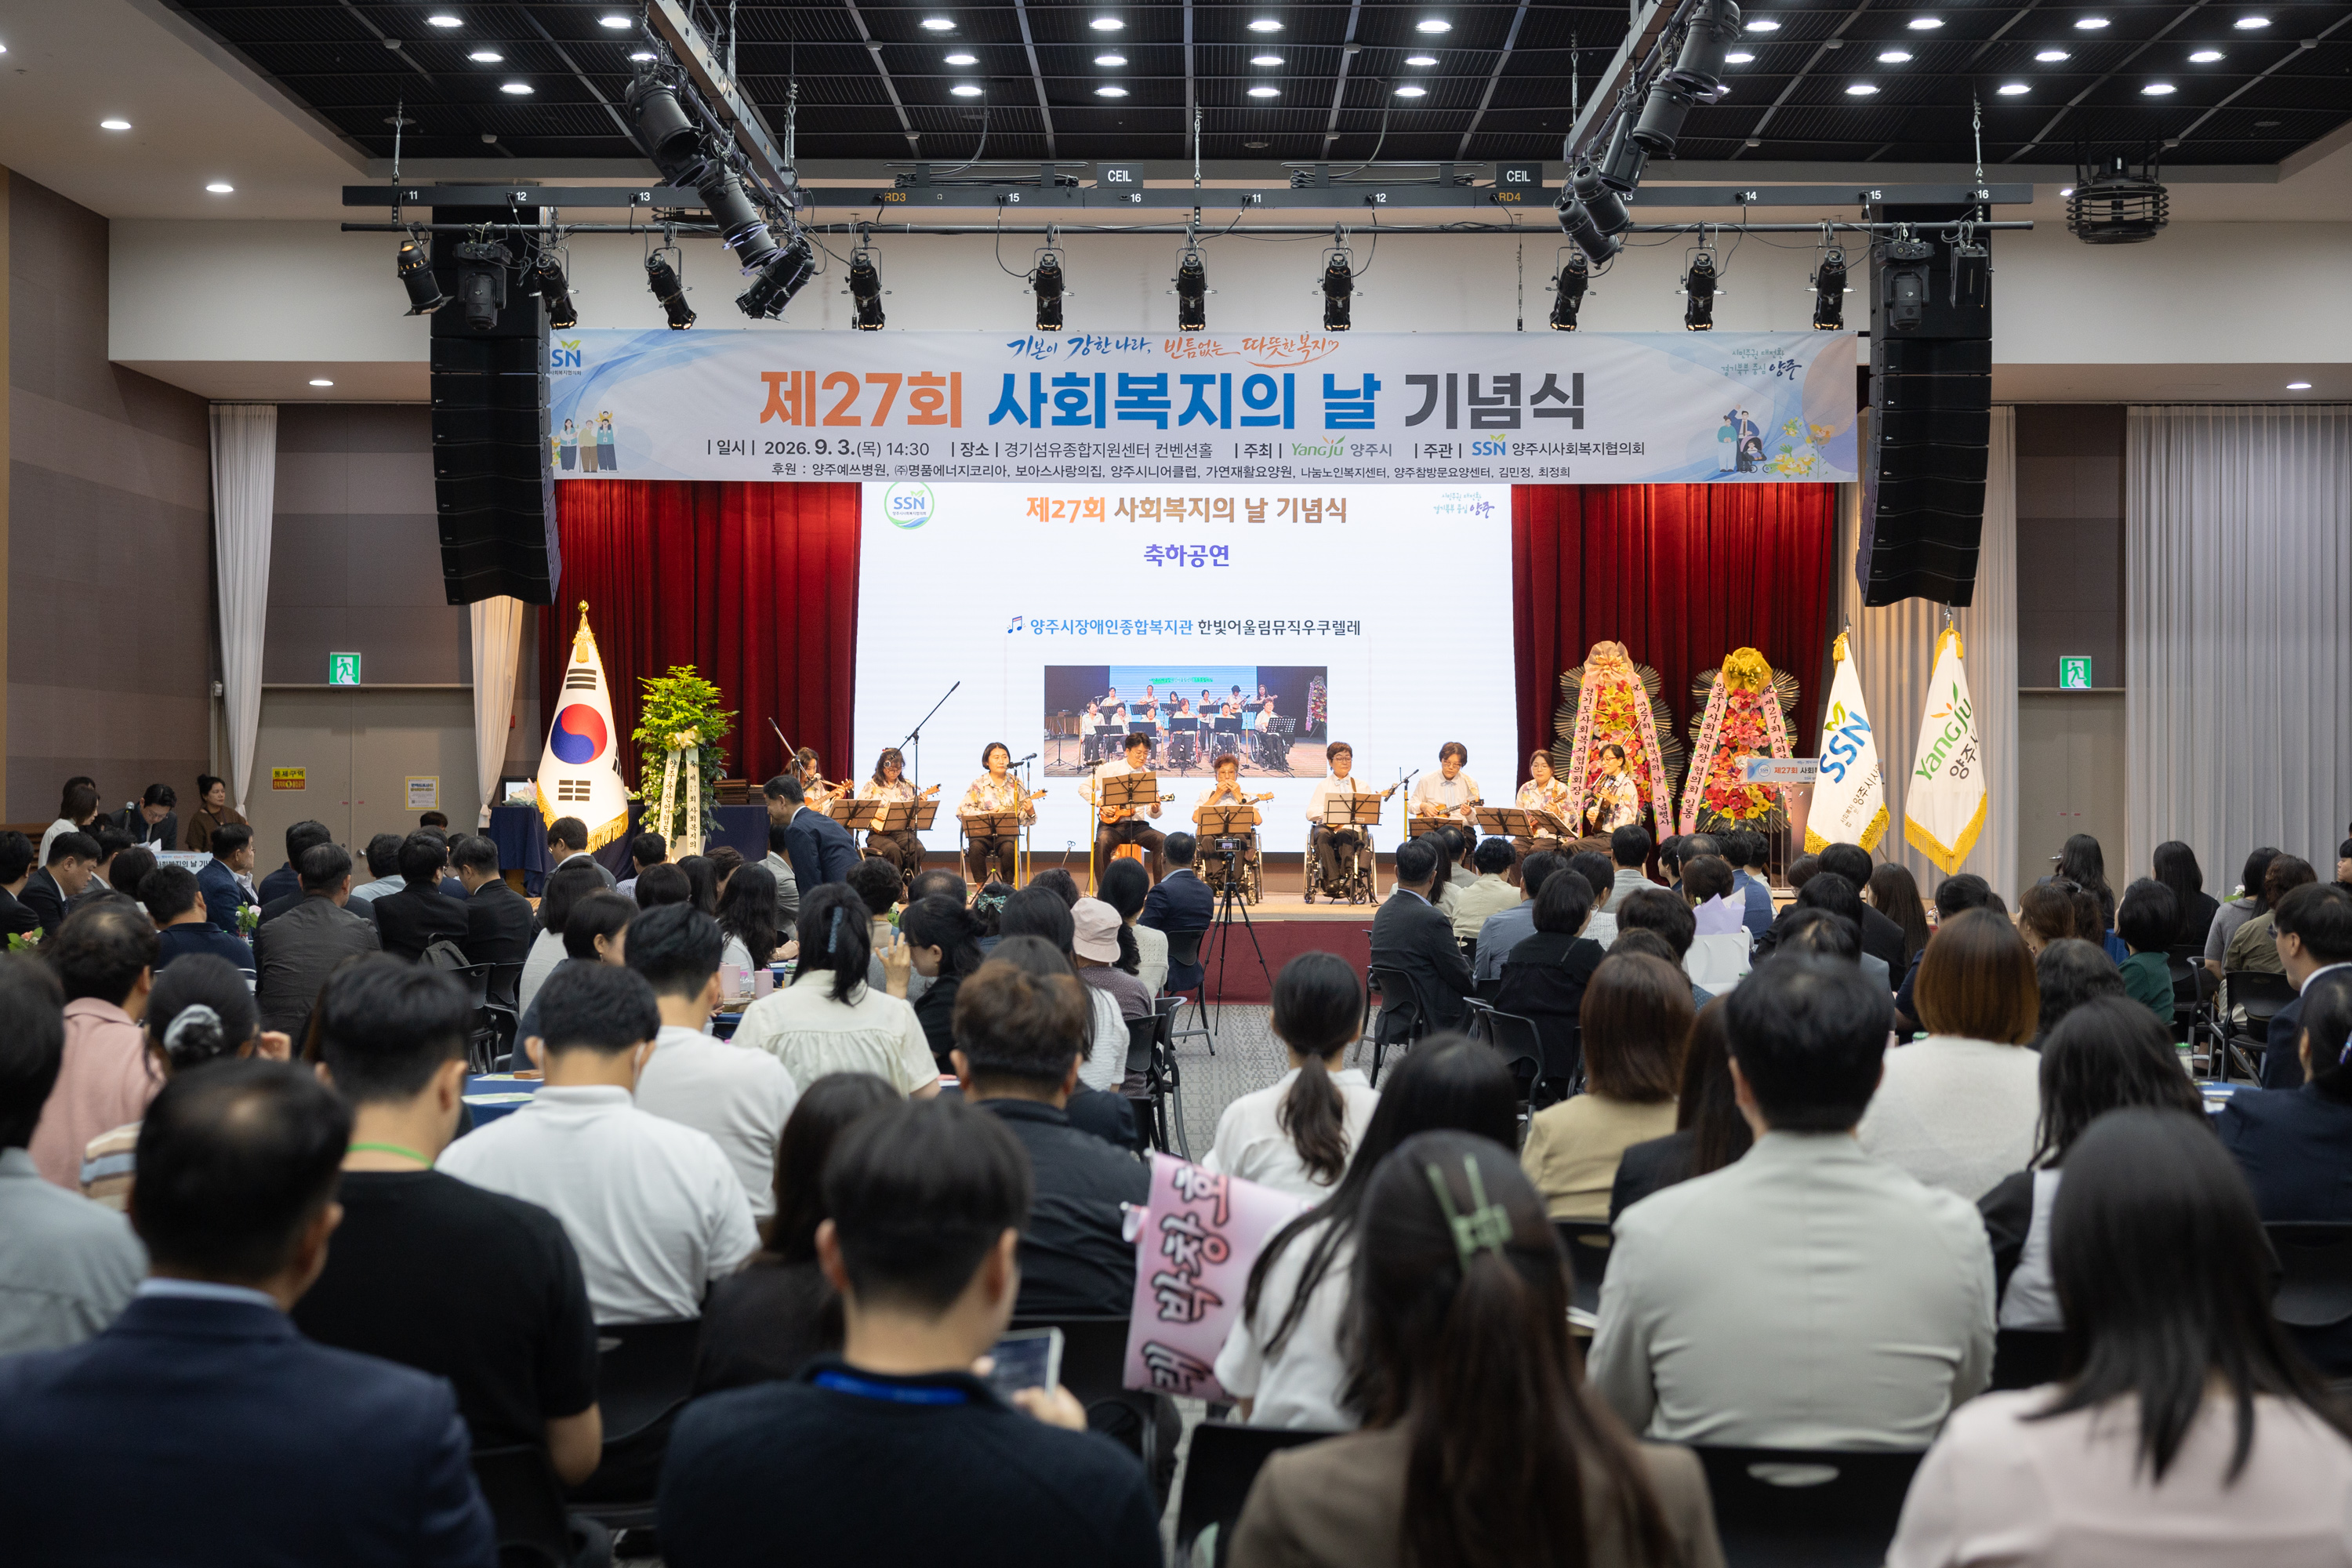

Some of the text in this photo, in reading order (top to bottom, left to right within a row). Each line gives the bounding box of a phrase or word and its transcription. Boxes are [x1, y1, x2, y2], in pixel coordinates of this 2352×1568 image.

[1107, 169, 1132, 182] CEIL
[1506, 170, 1531, 183] CEIL
[408, 191, 418, 200] 11
[516, 192, 527, 201] 12
[639, 191, 651, 201] 13
[884, 191, 908, 204] RD3
[1008, 192, 1020, 202] 15
[1130, 193, 1142, 203] 16
[1252, 193, 1261, 203] 11
[1375, 193, 1387, 203] 12
[1498, 192, 1521, 201] RD4
[1745, 191, 1758, 201] 14
[1870, 190, 1882, 200] 15
[1976, 188, 1991, 201] 16
[1006, 335, 1058, 361] 기본이
[1241, 335, 1296, 361] 따뜻한
[550, 347, 582, 368] SN
[1769, 358, 1802, 381] 양주
[760, 370, 1584, 430] 제27회 사회복지의 날 기념식
[717, 439, 745, 456] 일시
[764, 441, 811, 455] 2026.
[815, 438, 833, 456] 9.
[886, 442, 930, 456] 14:30
[960, 441, 990, 458] 장소
[1004, 441, 1149, 459] 경기섬유종합지원센터
[1155, 442, 1213, 459] 컨벤션홀
[1243, 442, 1272, 459] 주최
[1350, 443, 1392, 458] 양주시
[1423, 442, 1454, 459] 주관
[1470, 441, 1507, 458] SSN
[1512, 441, 1645, 456] 양주시사회복지협의회
[771, 463, 797, 476] 후원
[812, 463, 890, 477] 양주예쓰병원,
[1015, 464, 1105, 479] 보아스사랑의집,
[1110, 465, 1200, 479] 양주시니어클럽,
[1206, 465, 1296, 479] 가연재활요양원,
[1301, 466, 1390, 479] 나눔노인복지센터,
[1394, 466, 1494, 479] 양주참방문요양센터,
[1498, 466, 1534, 478] 김민정,
[1538, 466, 1570, 478] 최정희
[893, 496, 925, 510] SSN
[1025, 496, 1347, 524] 제27회 사회복지의 날 기념식
[1143, 543, 1229, 568] 축하공연
[1030, 619, 1360, 636] 양주시장애인종합복지관 한빛어울림뮤직우쿠렐레
[1820, 710, 1871, 784] SSN
[1656, 795, 1672, 826] 기념행사
